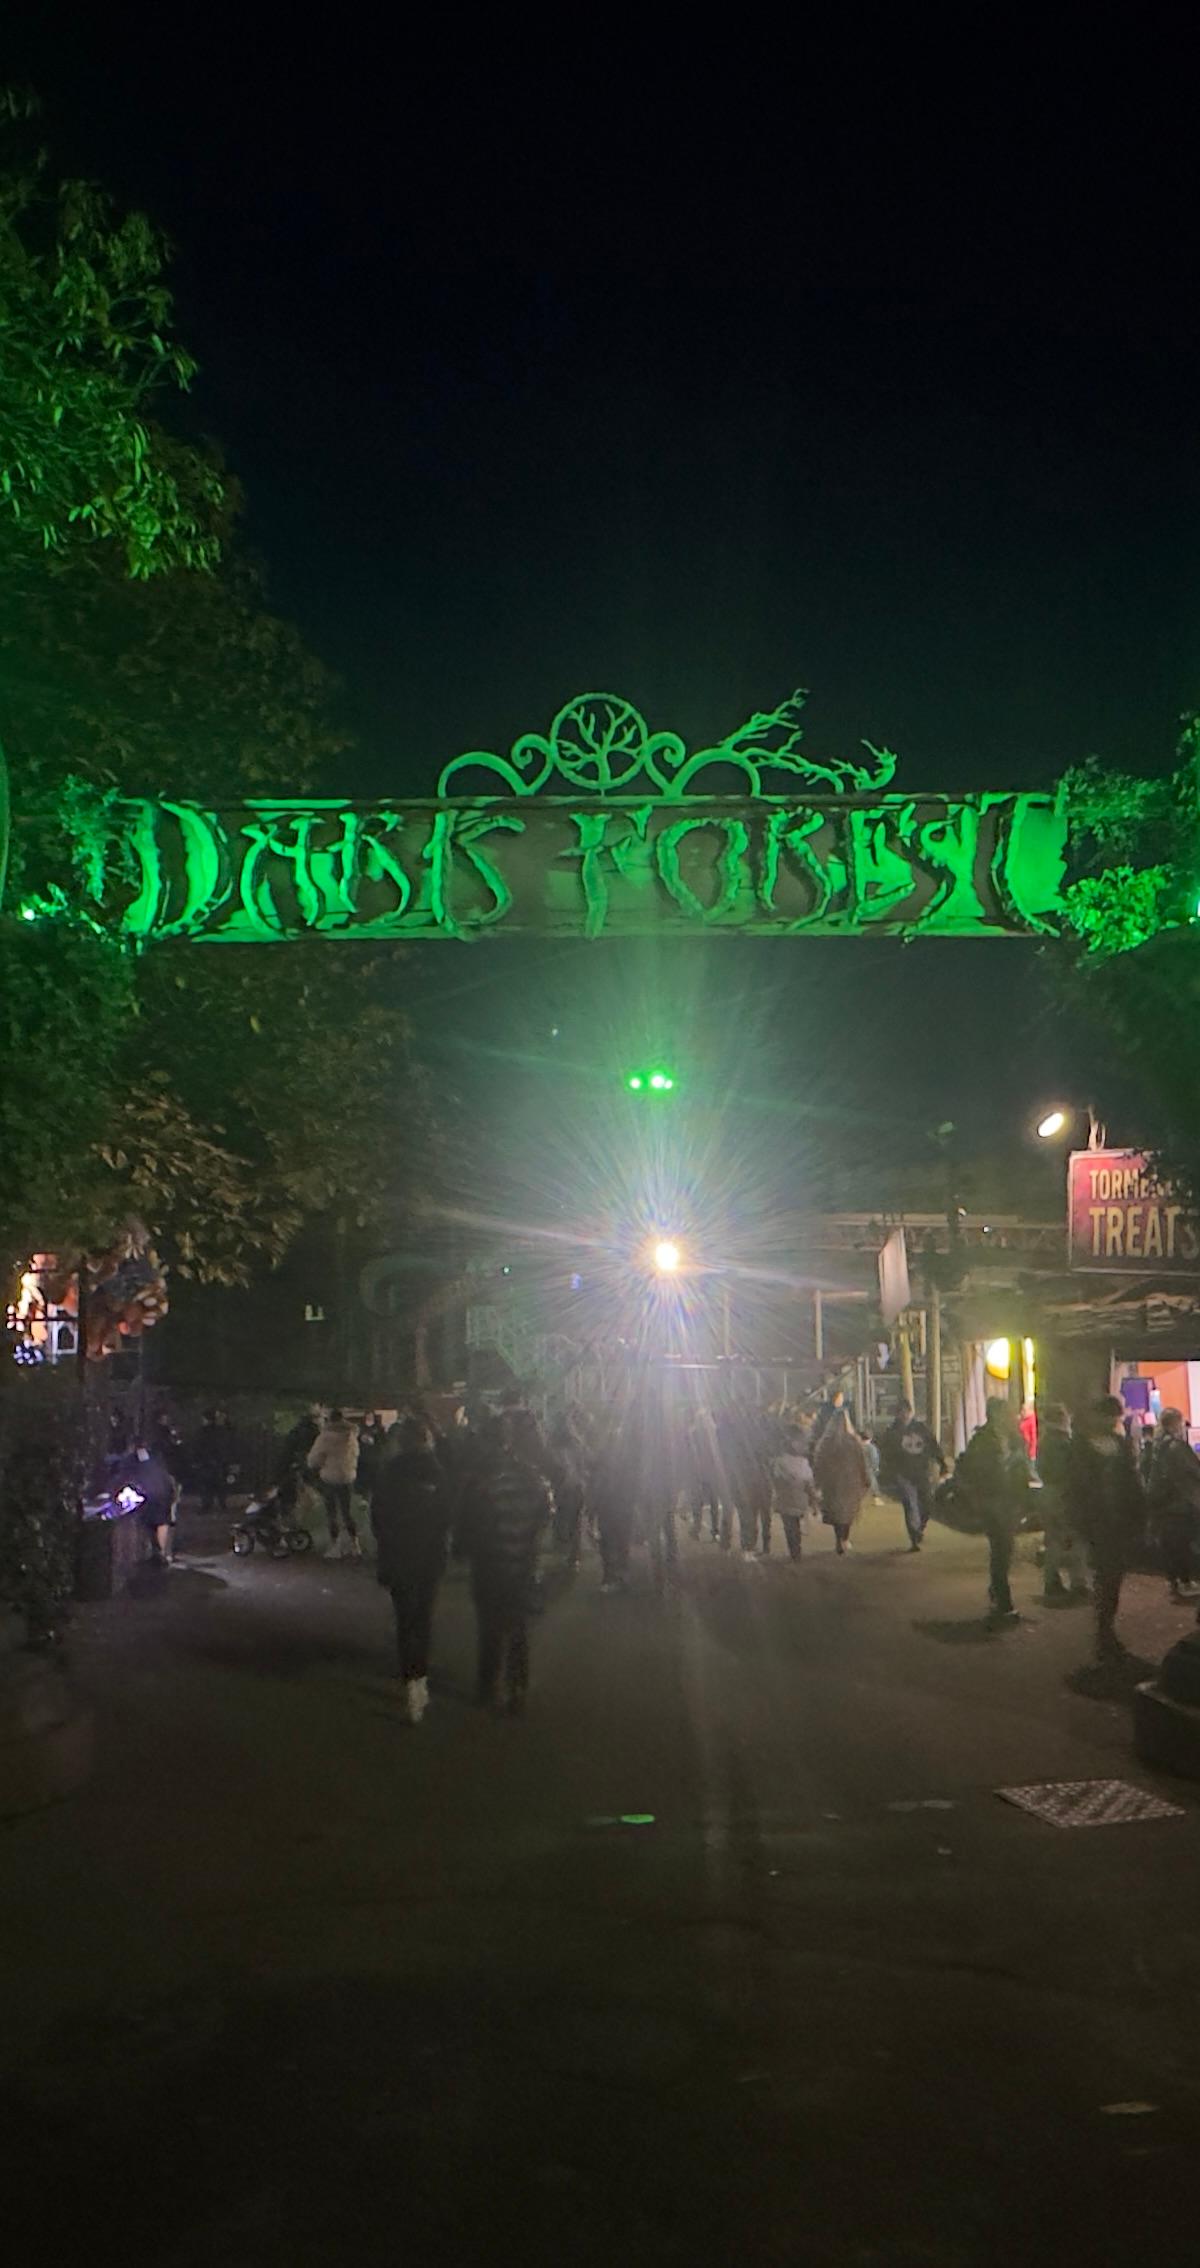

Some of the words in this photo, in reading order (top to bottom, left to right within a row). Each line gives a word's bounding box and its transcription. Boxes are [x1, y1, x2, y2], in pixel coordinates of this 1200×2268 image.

[128, 798, 526, 940] DARK
[560, 796, 1064, 938] FOREST
[1089, 1205, 1199, 1259] TREATS
